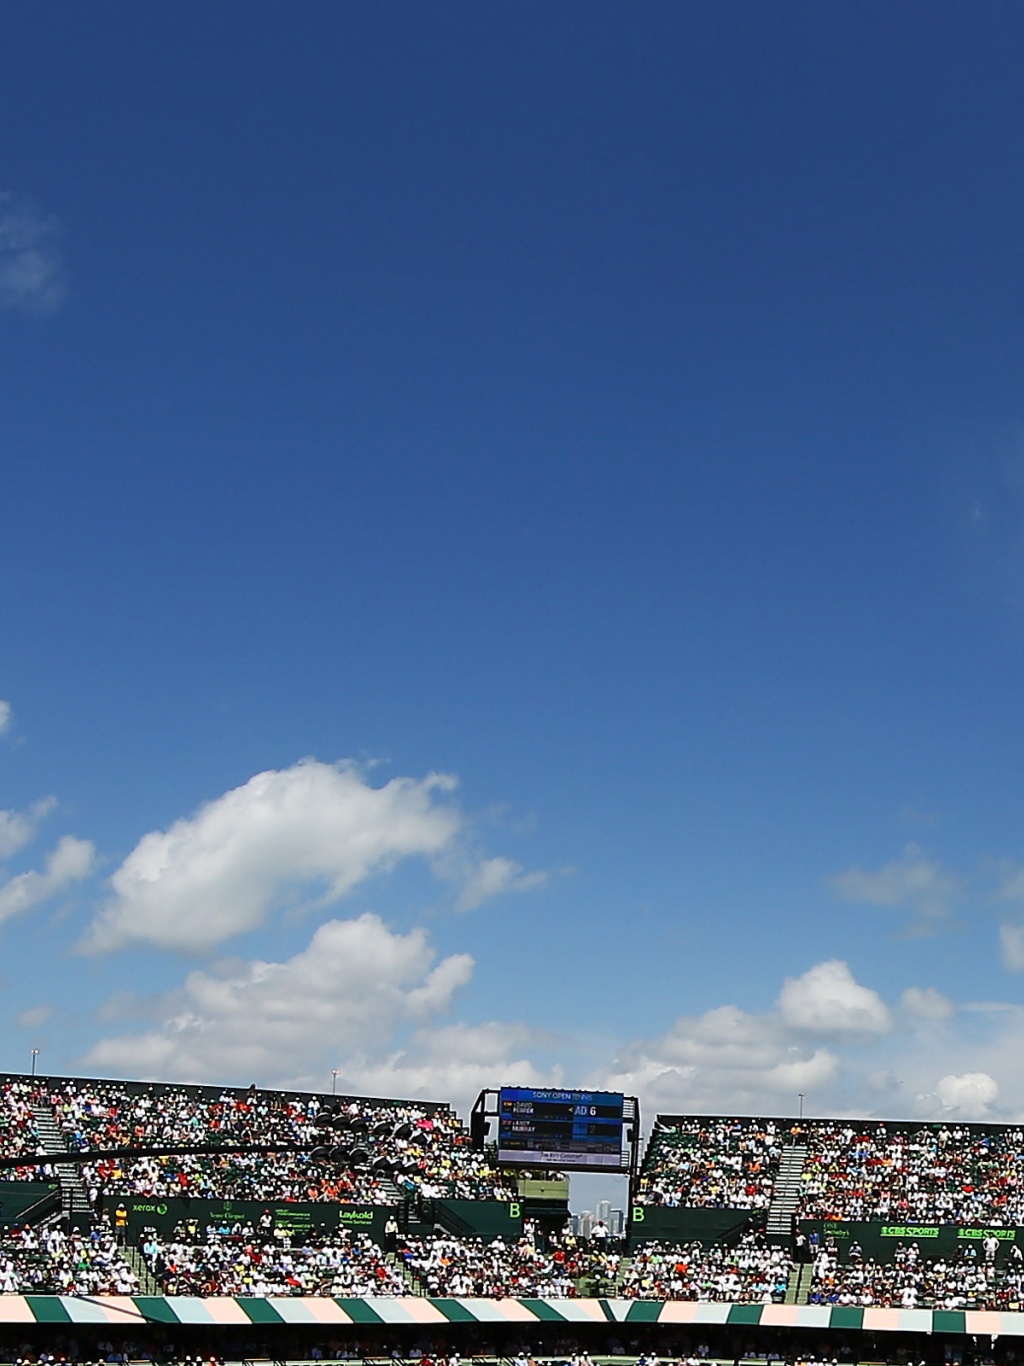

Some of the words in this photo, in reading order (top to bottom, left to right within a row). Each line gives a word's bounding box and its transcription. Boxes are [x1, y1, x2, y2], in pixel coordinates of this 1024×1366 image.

[552, 1092, 571, 1100] OPEN
[574, 1106, 587, 1115] AD
[589, 1106, 596, 1116] 6
[132, 1204, 155, 1212] xerox
[509, 1202, 521, 1218] B
[339, 1210, 373, 1219] Laykold
[632, 1207, 645, 1222] B
[906, 1227, 940, 1236] SPORTS
